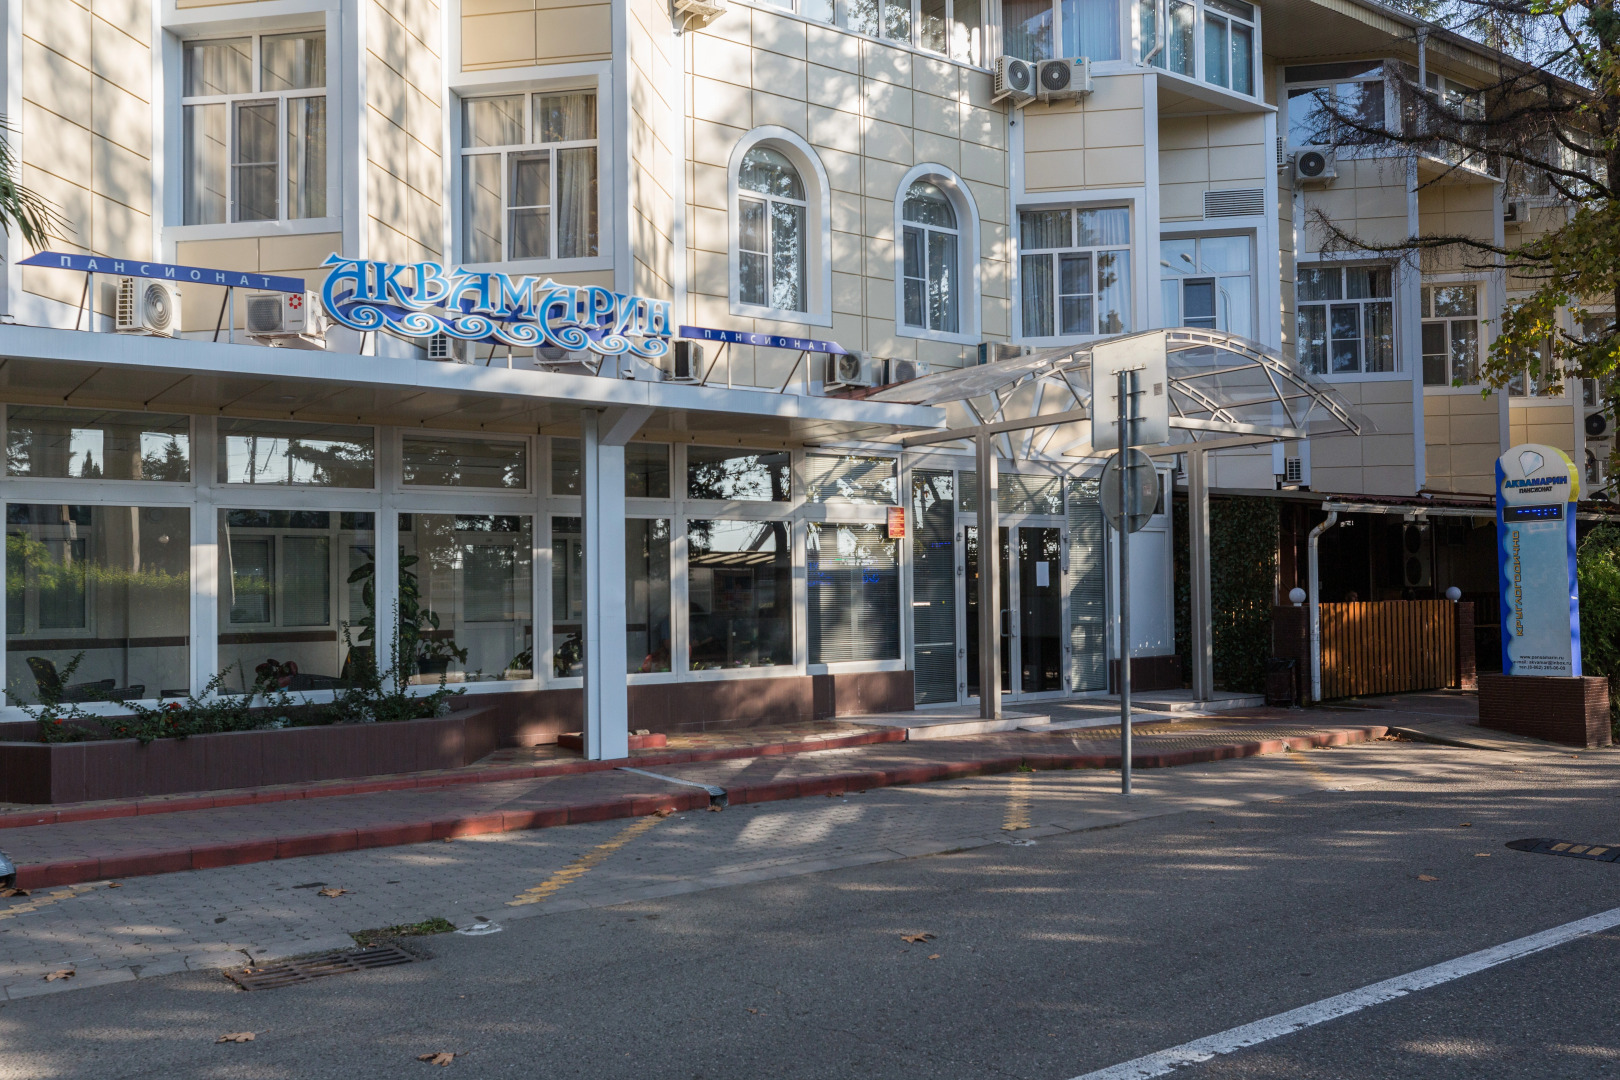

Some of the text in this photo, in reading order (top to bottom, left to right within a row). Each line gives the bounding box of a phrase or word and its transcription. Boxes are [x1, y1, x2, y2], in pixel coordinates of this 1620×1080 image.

[59, 255, 271, 288] ПАНСИОНАТ
[319, 252, 673, 351] АКВАМАРИН
[704, 329, 827, 351] ПАНСИОНАТ
[1505, 476, 1567, 488] АКВАМАРИН
[1519, 486, 1552, 494] ПАНСИОНАТ
[1512, 530, 1523, 636] КРУГЛОГОДИЧНО
